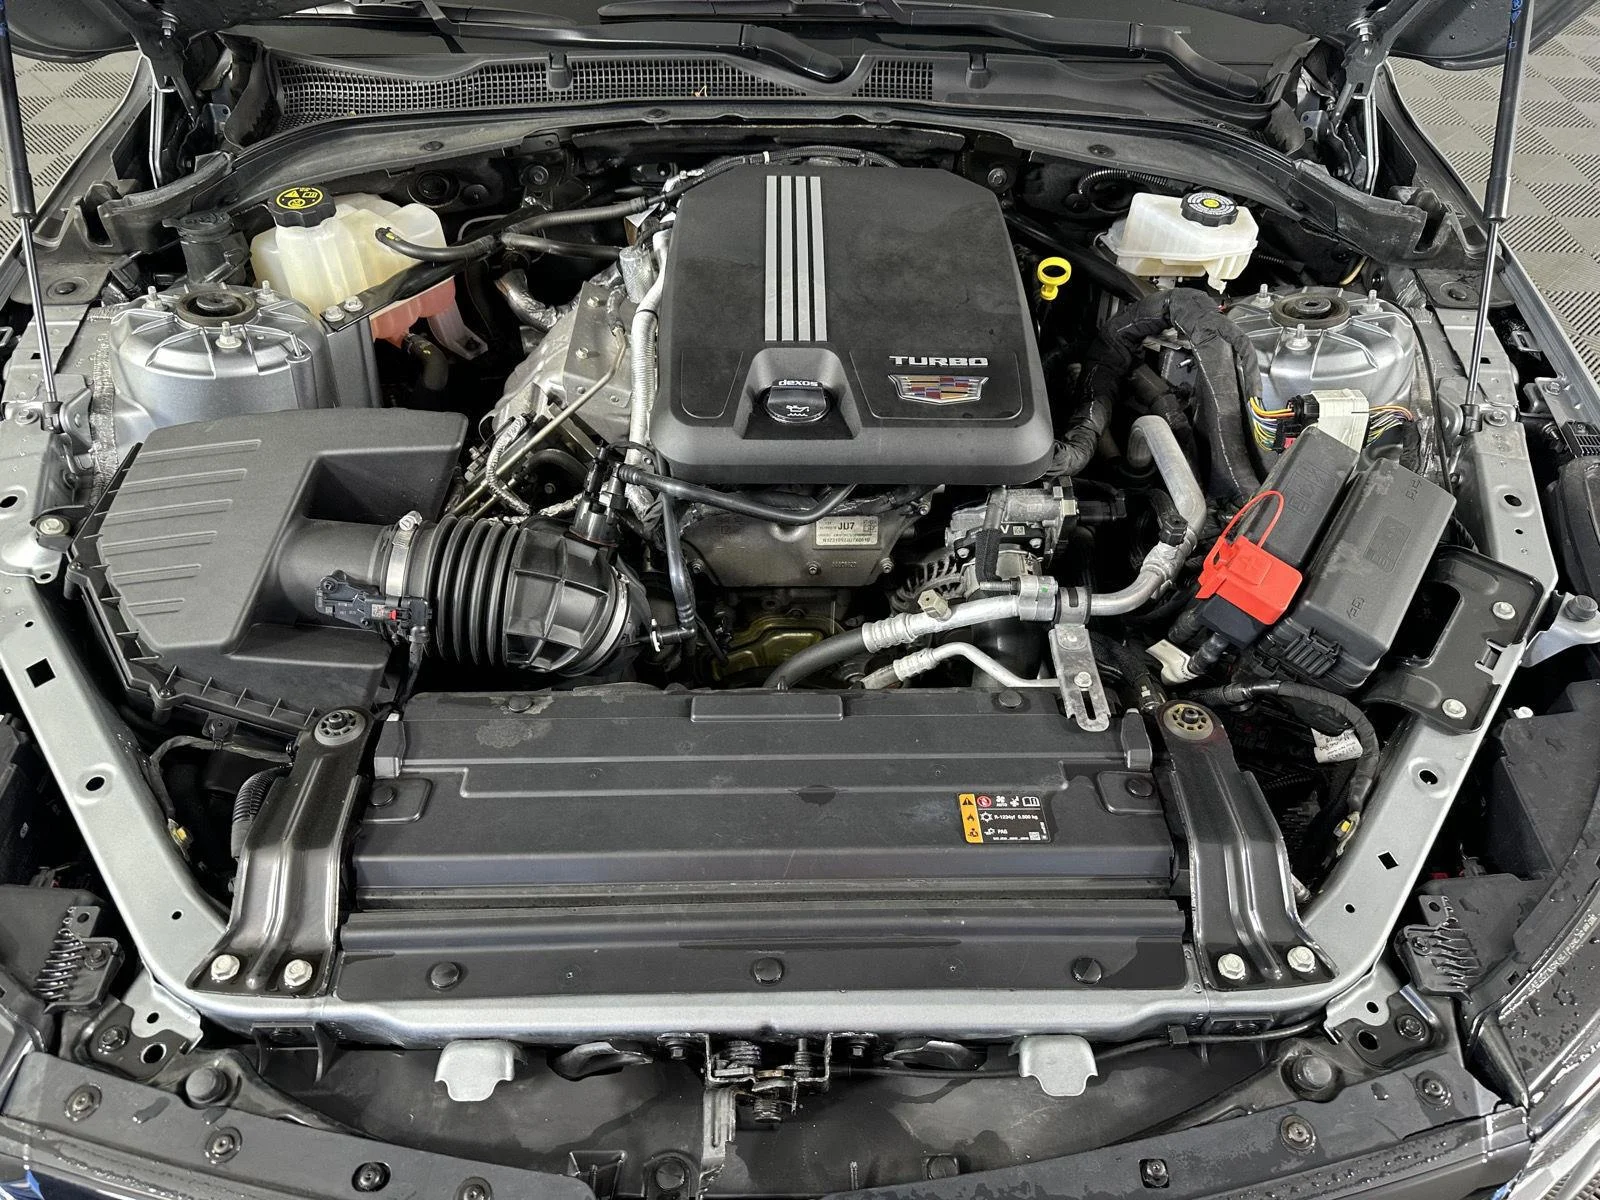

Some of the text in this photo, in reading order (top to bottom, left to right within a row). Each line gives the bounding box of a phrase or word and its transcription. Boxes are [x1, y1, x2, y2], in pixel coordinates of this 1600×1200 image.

[889, 355, 988, 367] TURBO
[778, 379, 819, 387] dexos
[838, 522, 855, 530] JU7
